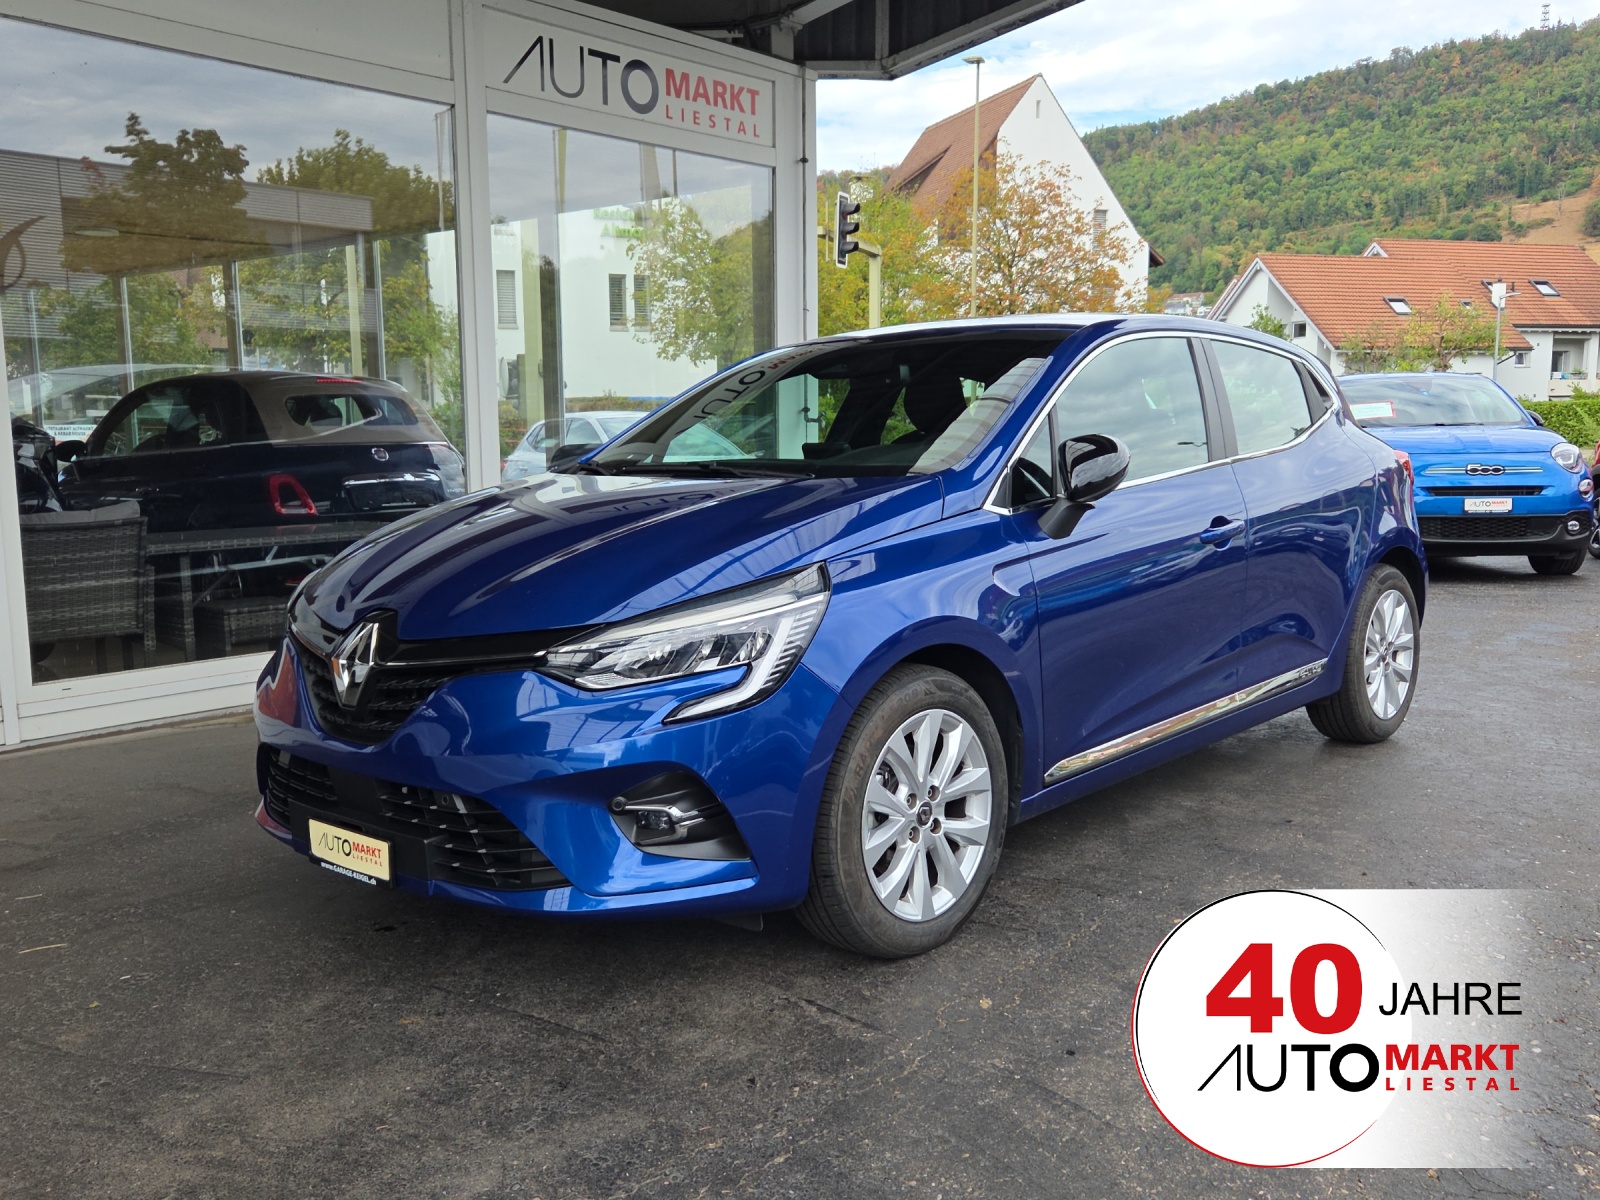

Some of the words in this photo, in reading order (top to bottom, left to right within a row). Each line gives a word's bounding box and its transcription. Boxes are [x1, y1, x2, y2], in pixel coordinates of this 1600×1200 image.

[503, 35, 659, 114] AUTO
[665, 67, 760, 116] MARKT
[665, 104, 760, 138] LIESTAL
[1465, 463, 1506, 476] 500
[318, 832, 352, 857] AUTO
[352, 841, 382, 859] MARKT
[352, 855, 383, 867] LIESTAL
